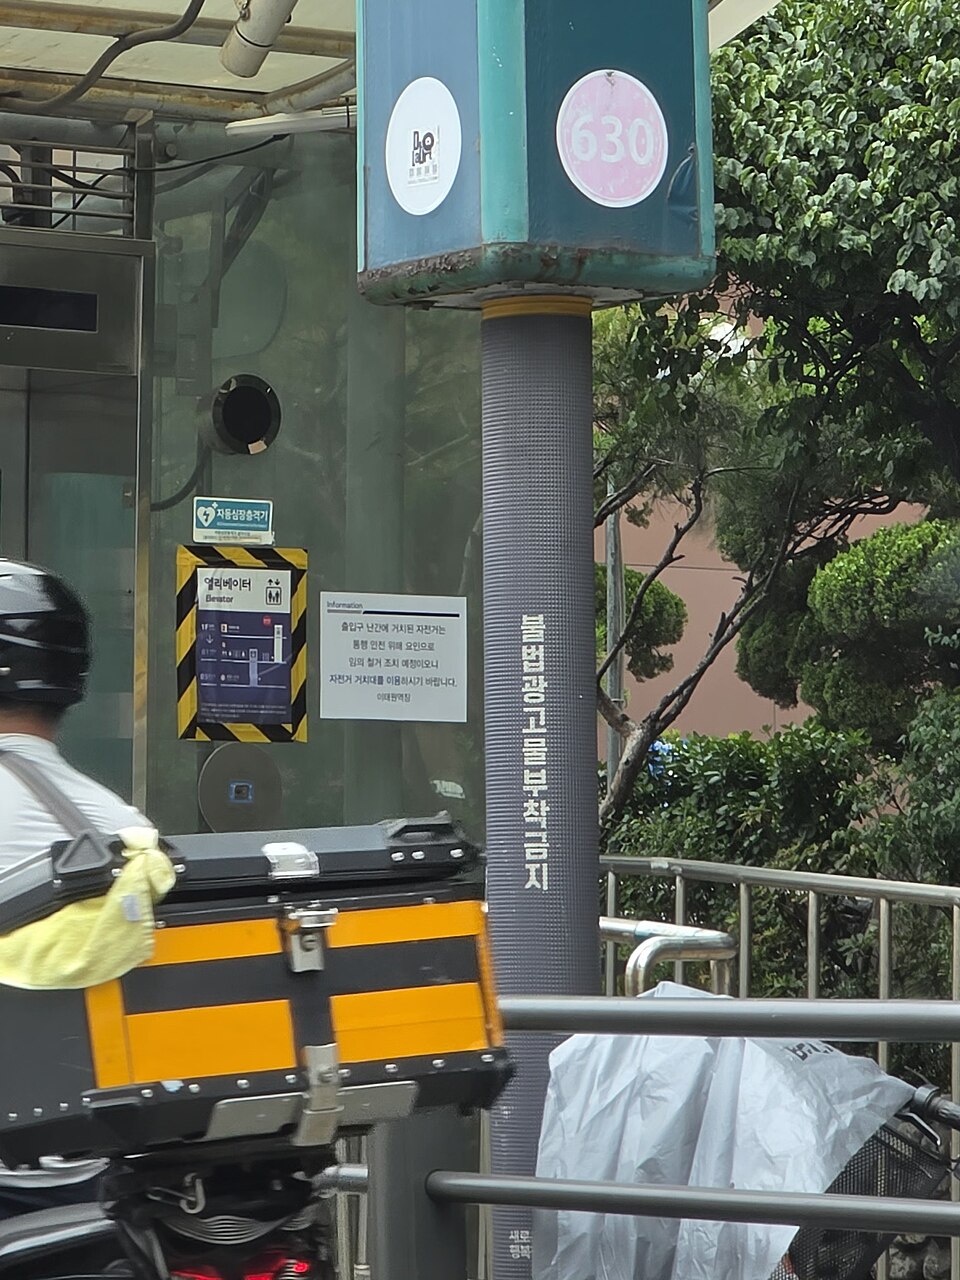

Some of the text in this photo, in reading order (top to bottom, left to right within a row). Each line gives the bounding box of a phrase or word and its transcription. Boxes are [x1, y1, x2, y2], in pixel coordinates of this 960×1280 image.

[571, 114, 654, 166] 630
[326, 601, 363, 609] Information
[341, 622, 364, 632] 출입구
